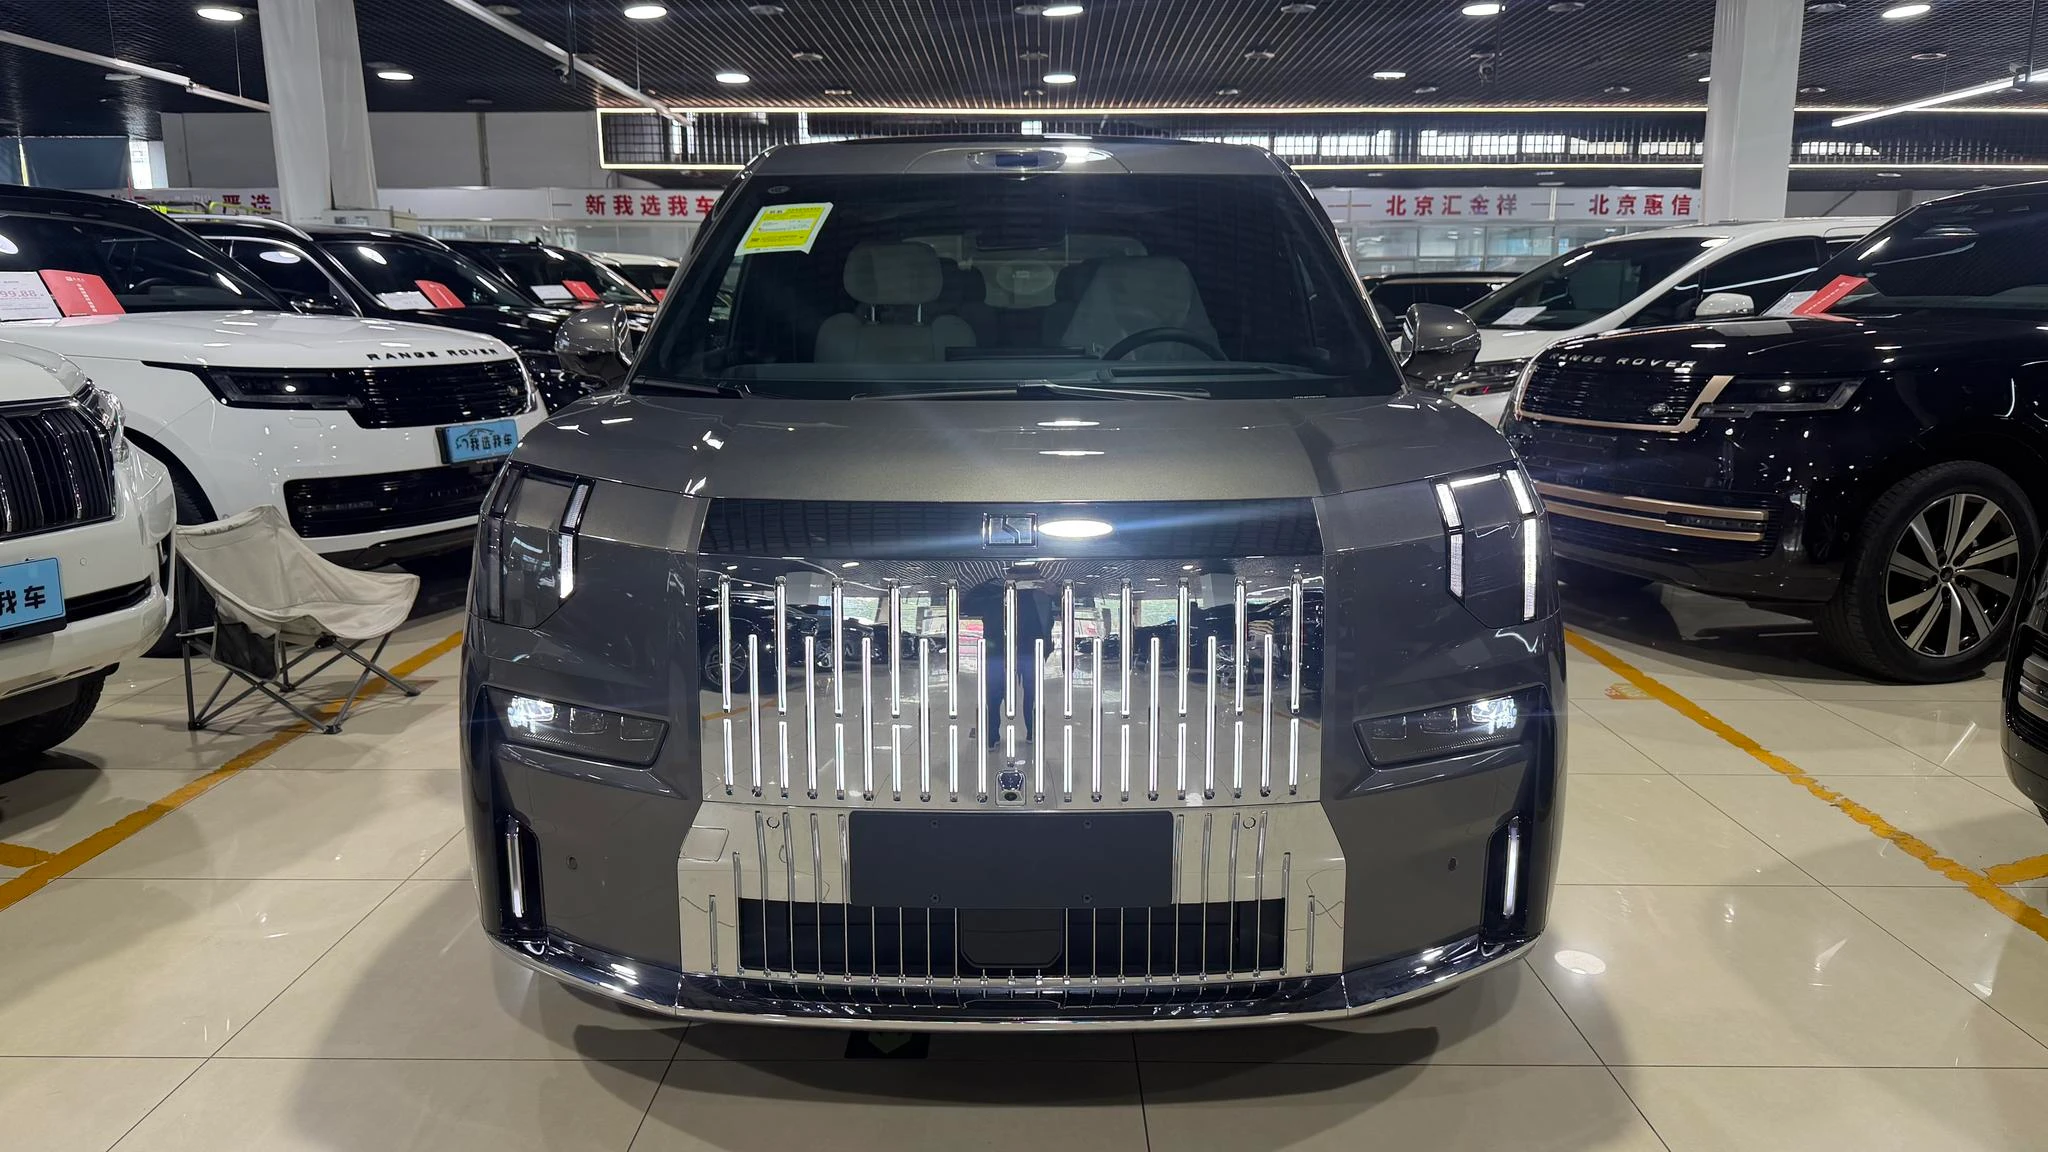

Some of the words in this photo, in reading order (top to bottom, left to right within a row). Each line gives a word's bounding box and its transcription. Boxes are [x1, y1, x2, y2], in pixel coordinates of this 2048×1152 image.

[585, 193, 716, 217] 新我选我车
[1385, 193, 1518, 217] 北京汇金祥
[1588, 193, 1700, 217] 北京惠信
[366, 351, 438, 361] RANGE
[446, 348, 498, 357] ROVER
[1549, 353, 1606, 364] RANGE
[1616, 357, 1697, 368] ROVER
